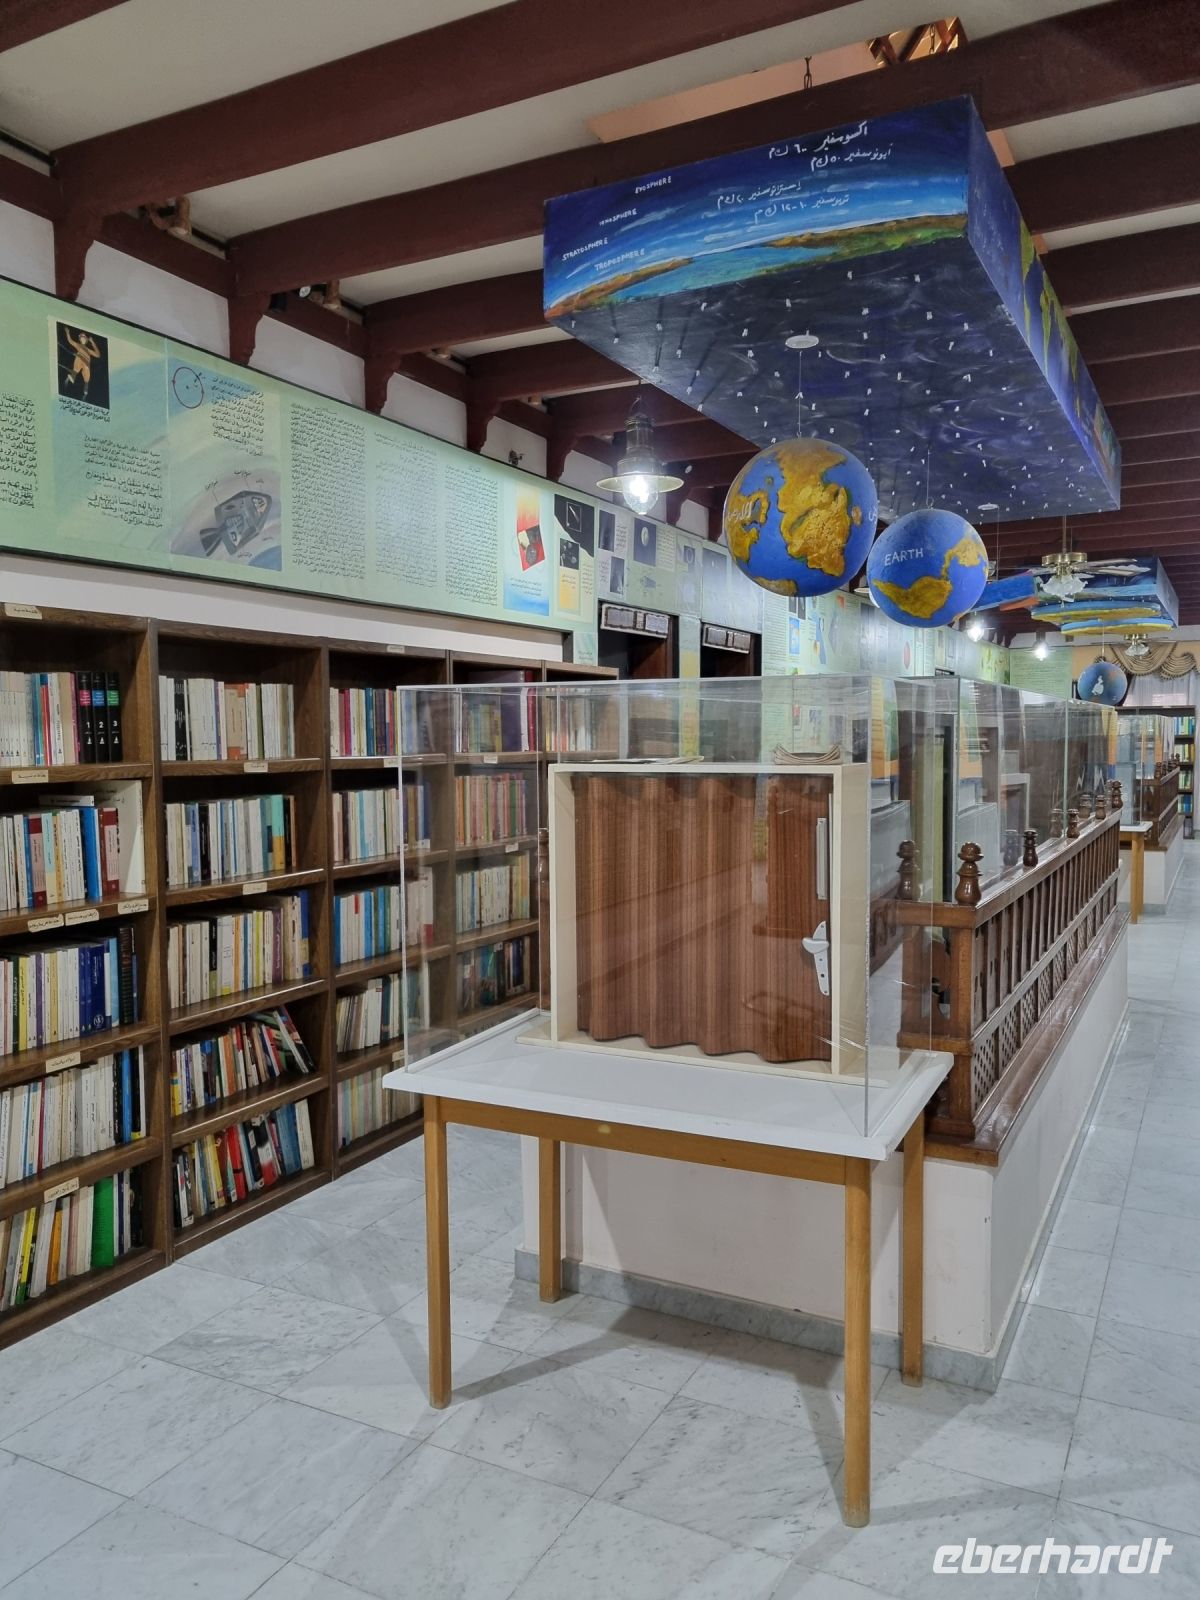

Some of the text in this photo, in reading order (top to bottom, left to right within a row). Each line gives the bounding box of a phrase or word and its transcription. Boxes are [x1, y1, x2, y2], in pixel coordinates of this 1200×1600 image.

[562, 236, 609, 261] STRATOSPHERE
[594, 248, 645, 271] TROPOSPHERE
[884, 547, 924, 567] EARTH
